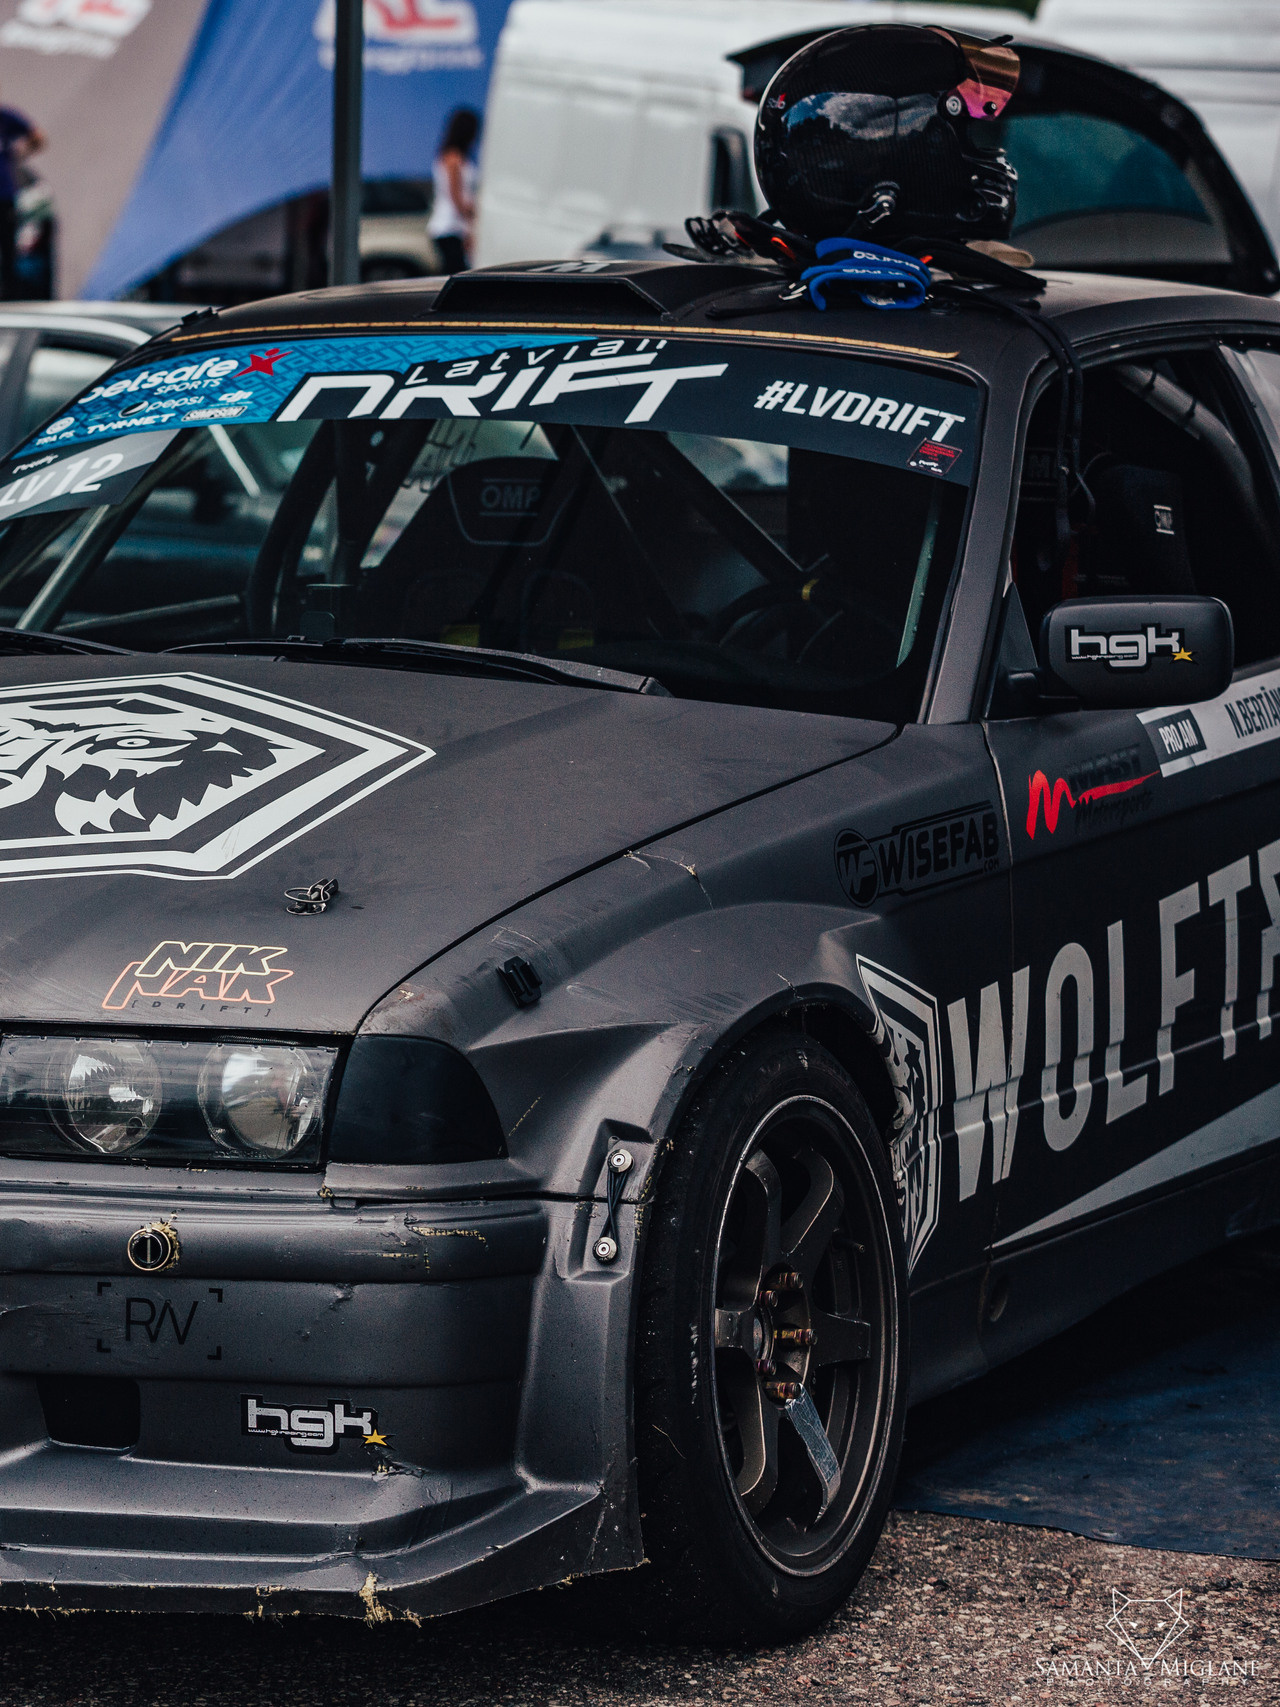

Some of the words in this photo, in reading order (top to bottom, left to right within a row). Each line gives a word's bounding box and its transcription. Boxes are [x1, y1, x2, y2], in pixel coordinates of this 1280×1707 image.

[404, 338, 668, 386] Latvian
[154, 378, 223, 395] SPORTS
[754, 379, 965, 442] #LVDRIFT
[480, 485, 541, 509] OMP
[1071, 627, 1180, 667] hgk
[1158, 723, 1183, 755] PRO
[1177, 718, 1199, 749] AM
[878, 811, 1000, 888] WISEFAB
[134, 940, 288, 977] NIK
[247, 1398, 373, 1448] hgk
